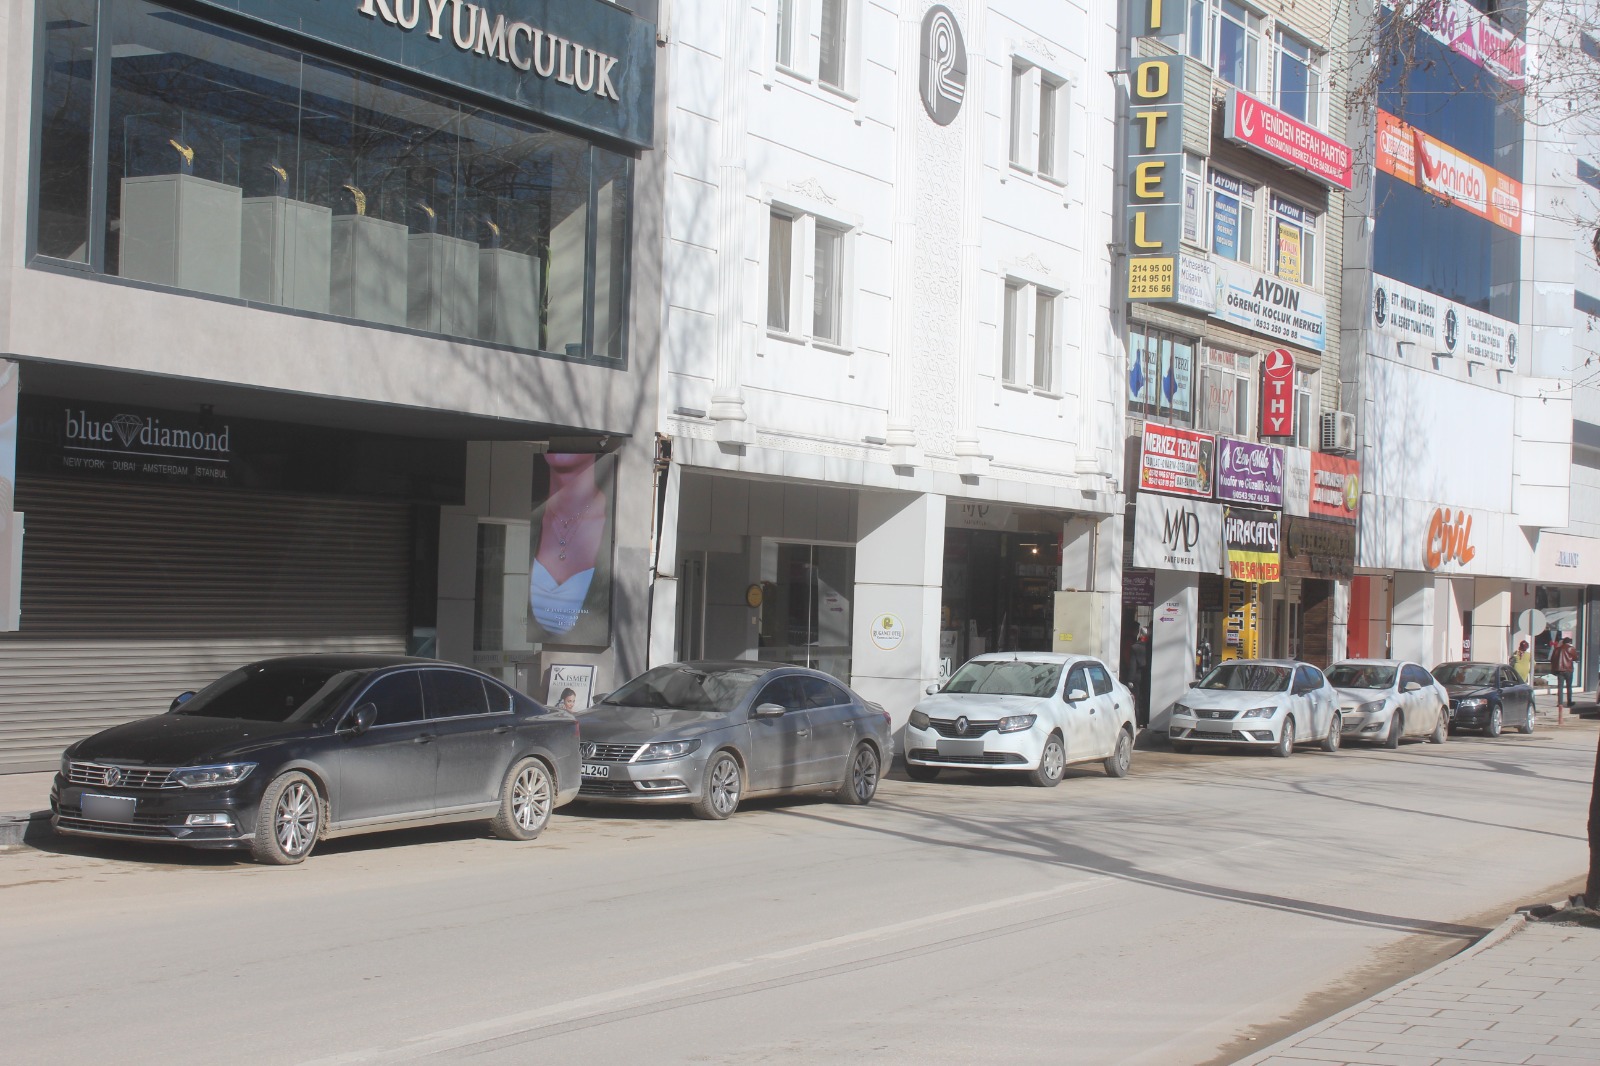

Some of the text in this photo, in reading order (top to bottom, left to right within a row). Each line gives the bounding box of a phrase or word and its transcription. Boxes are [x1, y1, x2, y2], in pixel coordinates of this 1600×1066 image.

[1260, 110, 1348, 168] YENİDEN REFAH PARTİSİ
[1264, 134, 1292, 156] KASTAMONU
[1292, 147, 1309, 164] MERKEZ
[1134, 61, 1169, 248] OTEL
[1215, 176, 1238, 193] AYDIN
[1279, 203, 1299, 218] AYDIN
[1132, 264, 1172, 272] 214 95 00
[1132, 274, 1171, 282] 214 95 01
[1131, 285, 1146, 293] 212
[1148, 285, 1159, 293] 56
[1252, 277, 1300, 312] AYDIN
[1227, 292, 1261, 315] ÖĞRENCİ
[1292, 317, 1323, 335] MERKEZİ
[1256, 319, 1270, 331] 0533
[1271, 322, 1281, 333] 250
[1175, 356, 1189, 372] TERZİ
[1270, 380, 1286, 432] THY
[65, 408, 230, 452] blue diamond
[1145, 432, 1199, 460] MERKEZ TERZİ
[63, 456, 82, 468] NEW
[83, 458, 105, 469] YORK
[142, 464, 188, 475] AMSTERDAM
[194, 466, 228, 479] İSTANBUL
[1220, 474, 1237, 487] Kuaför
[1238, 479, 1244, 489] ve
[1245, 478, 1264, 491] Güzellik
[1162, 505, 1200, 552] MAD
[1226, 517, 1278, 551] İHRACATÇI
[1164, 555, 1195, 565] PARFUMEUR
[553, 667, 590, 682] KISMET
